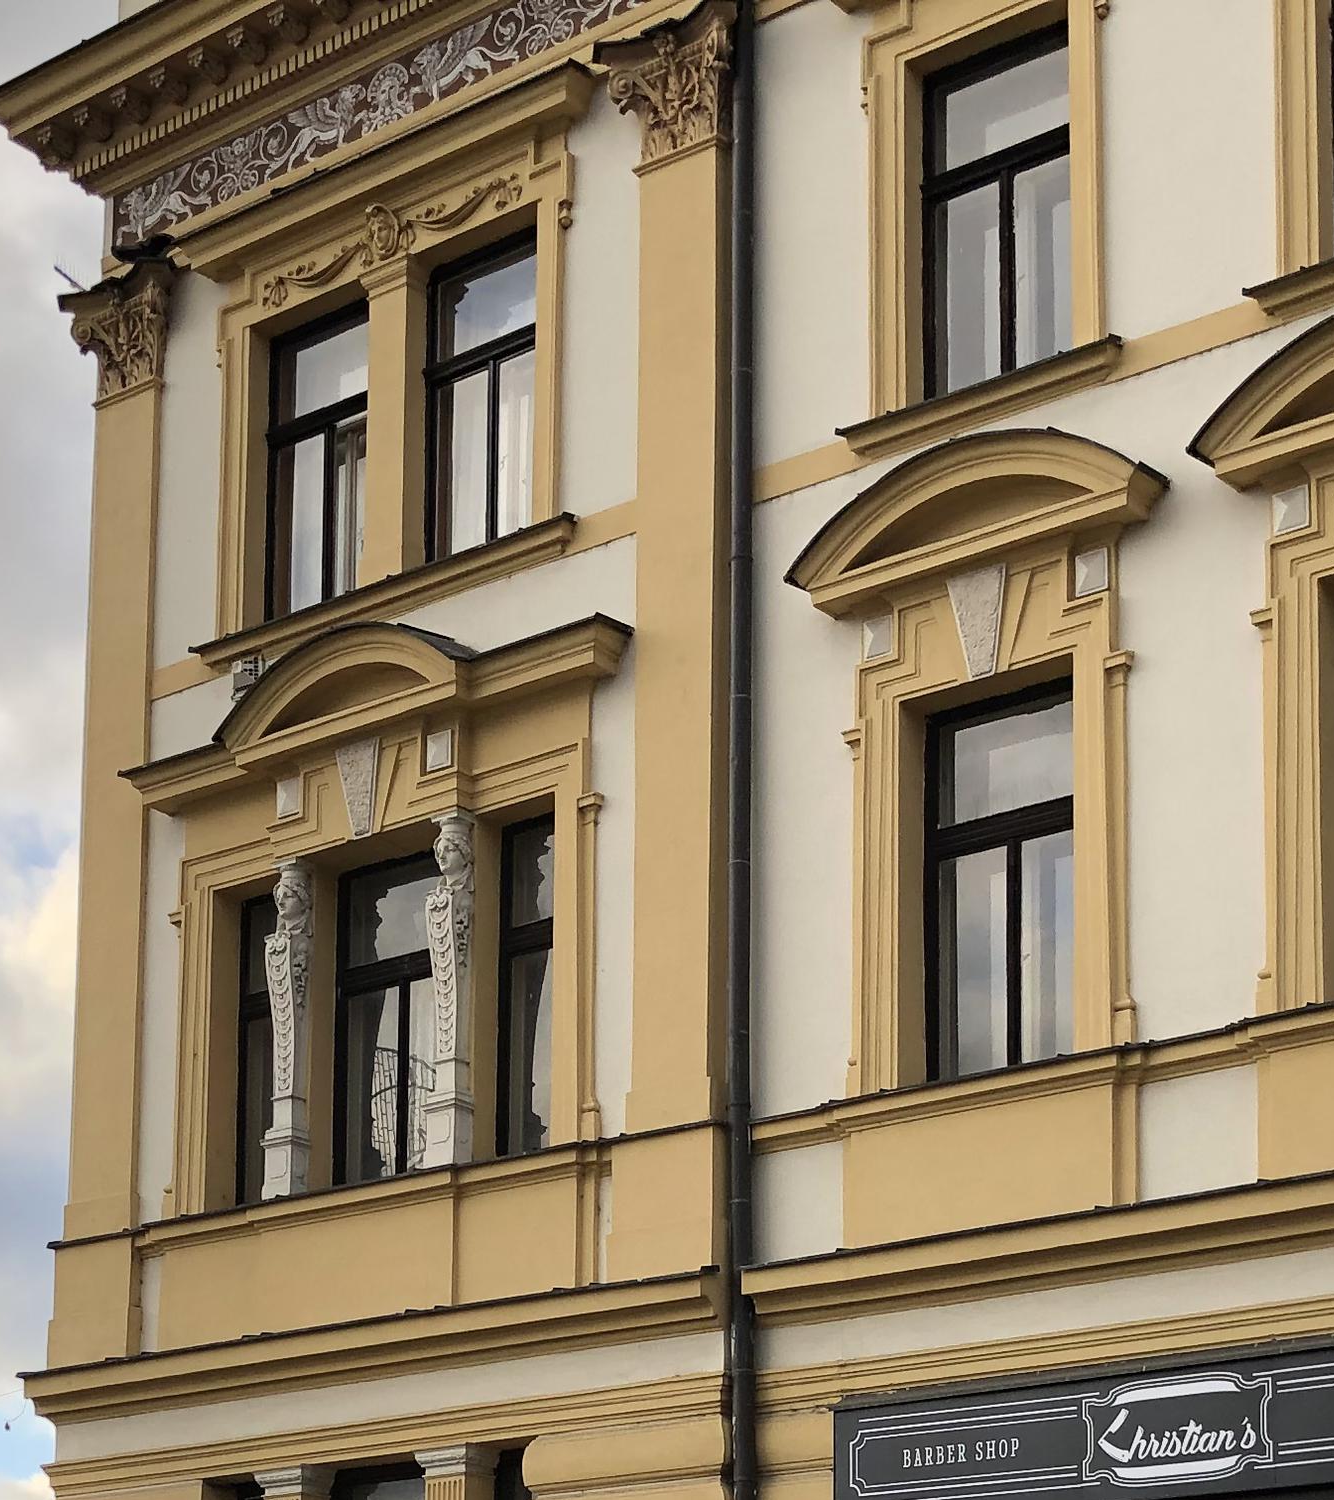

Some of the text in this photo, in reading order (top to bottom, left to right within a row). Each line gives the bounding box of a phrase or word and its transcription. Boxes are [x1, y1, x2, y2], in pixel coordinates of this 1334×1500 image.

[902, 1438, 1019, 1468] BARBER SHOP
[1098, 1408, 1257, 1463] Christian's
